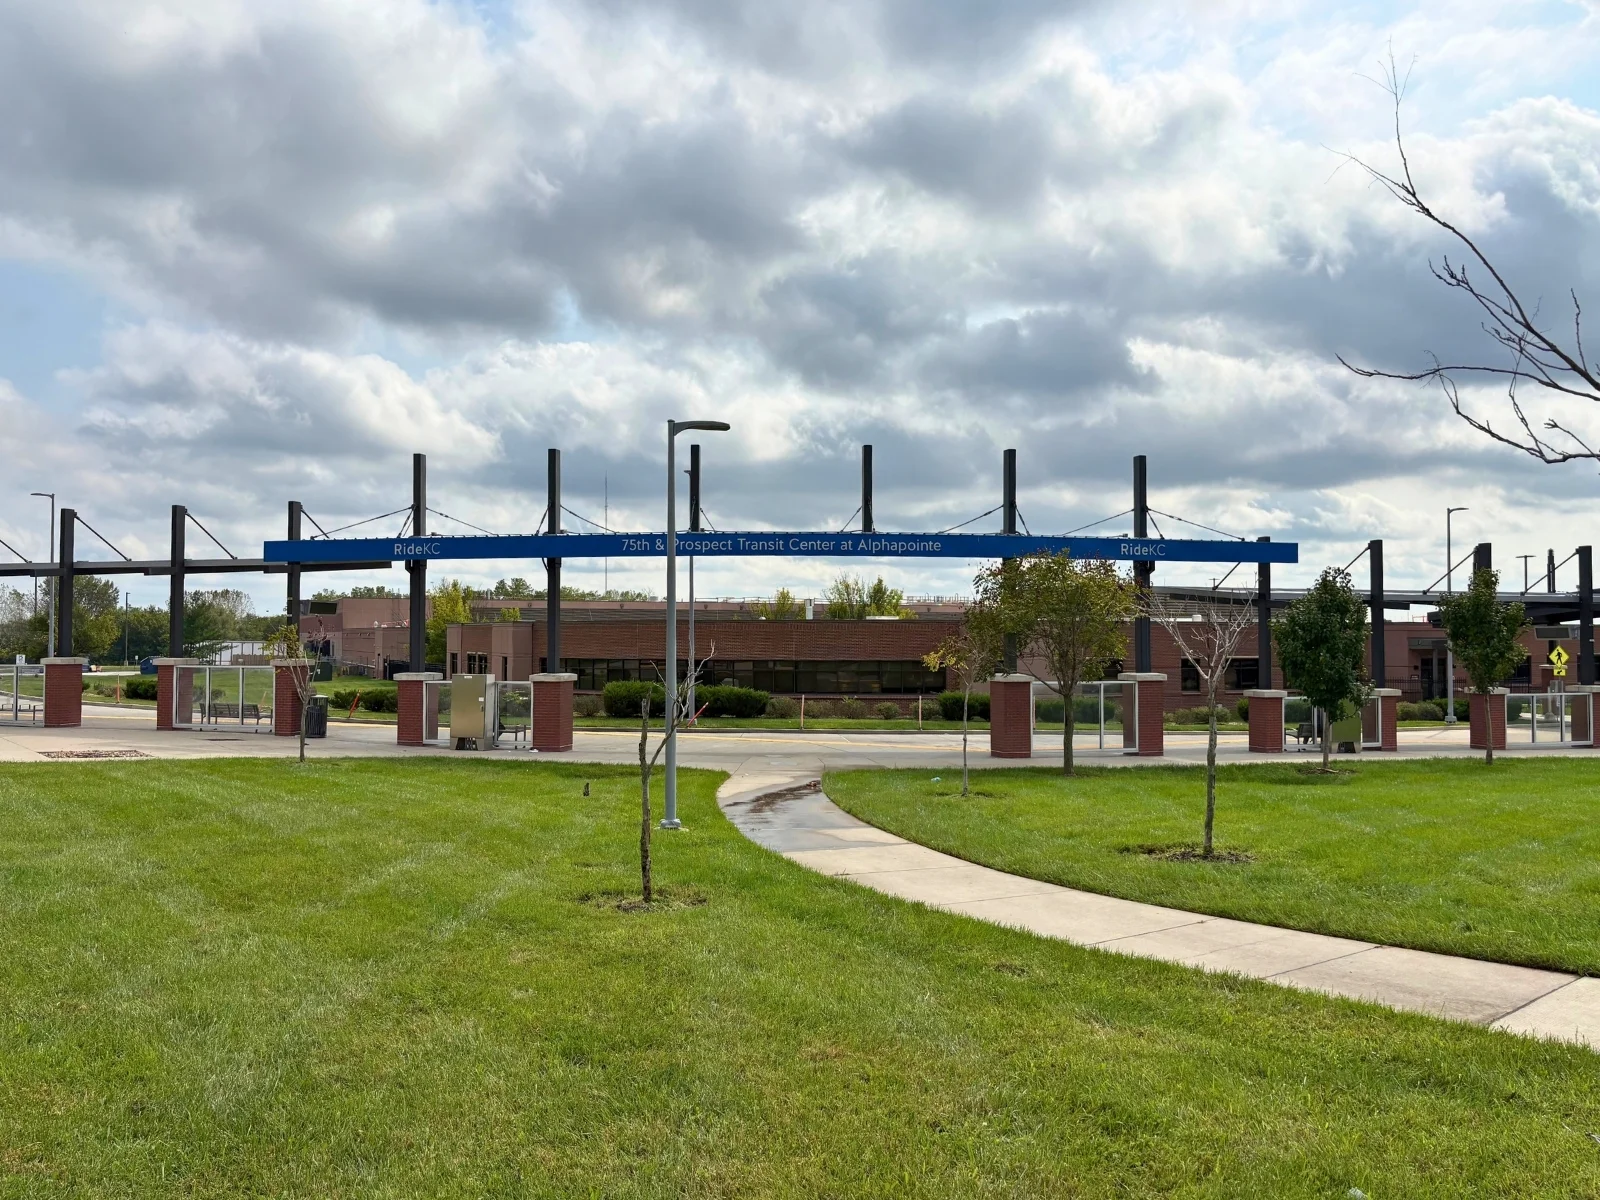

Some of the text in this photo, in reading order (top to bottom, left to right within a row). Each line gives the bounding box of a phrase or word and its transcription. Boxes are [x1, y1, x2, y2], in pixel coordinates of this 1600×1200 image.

[394, 543, 441, 555] RideKC
[621, 538, 650, 551] 75th
[655, 538, 665, 551] &
[737, 538, 785, 551] Transit
[789, 538, 836, 551] Center
[840, 539, 853, 551] at
[857, 538, 942, 554] Alphapointe
[1120, 543, 1166, 556] RideKC
